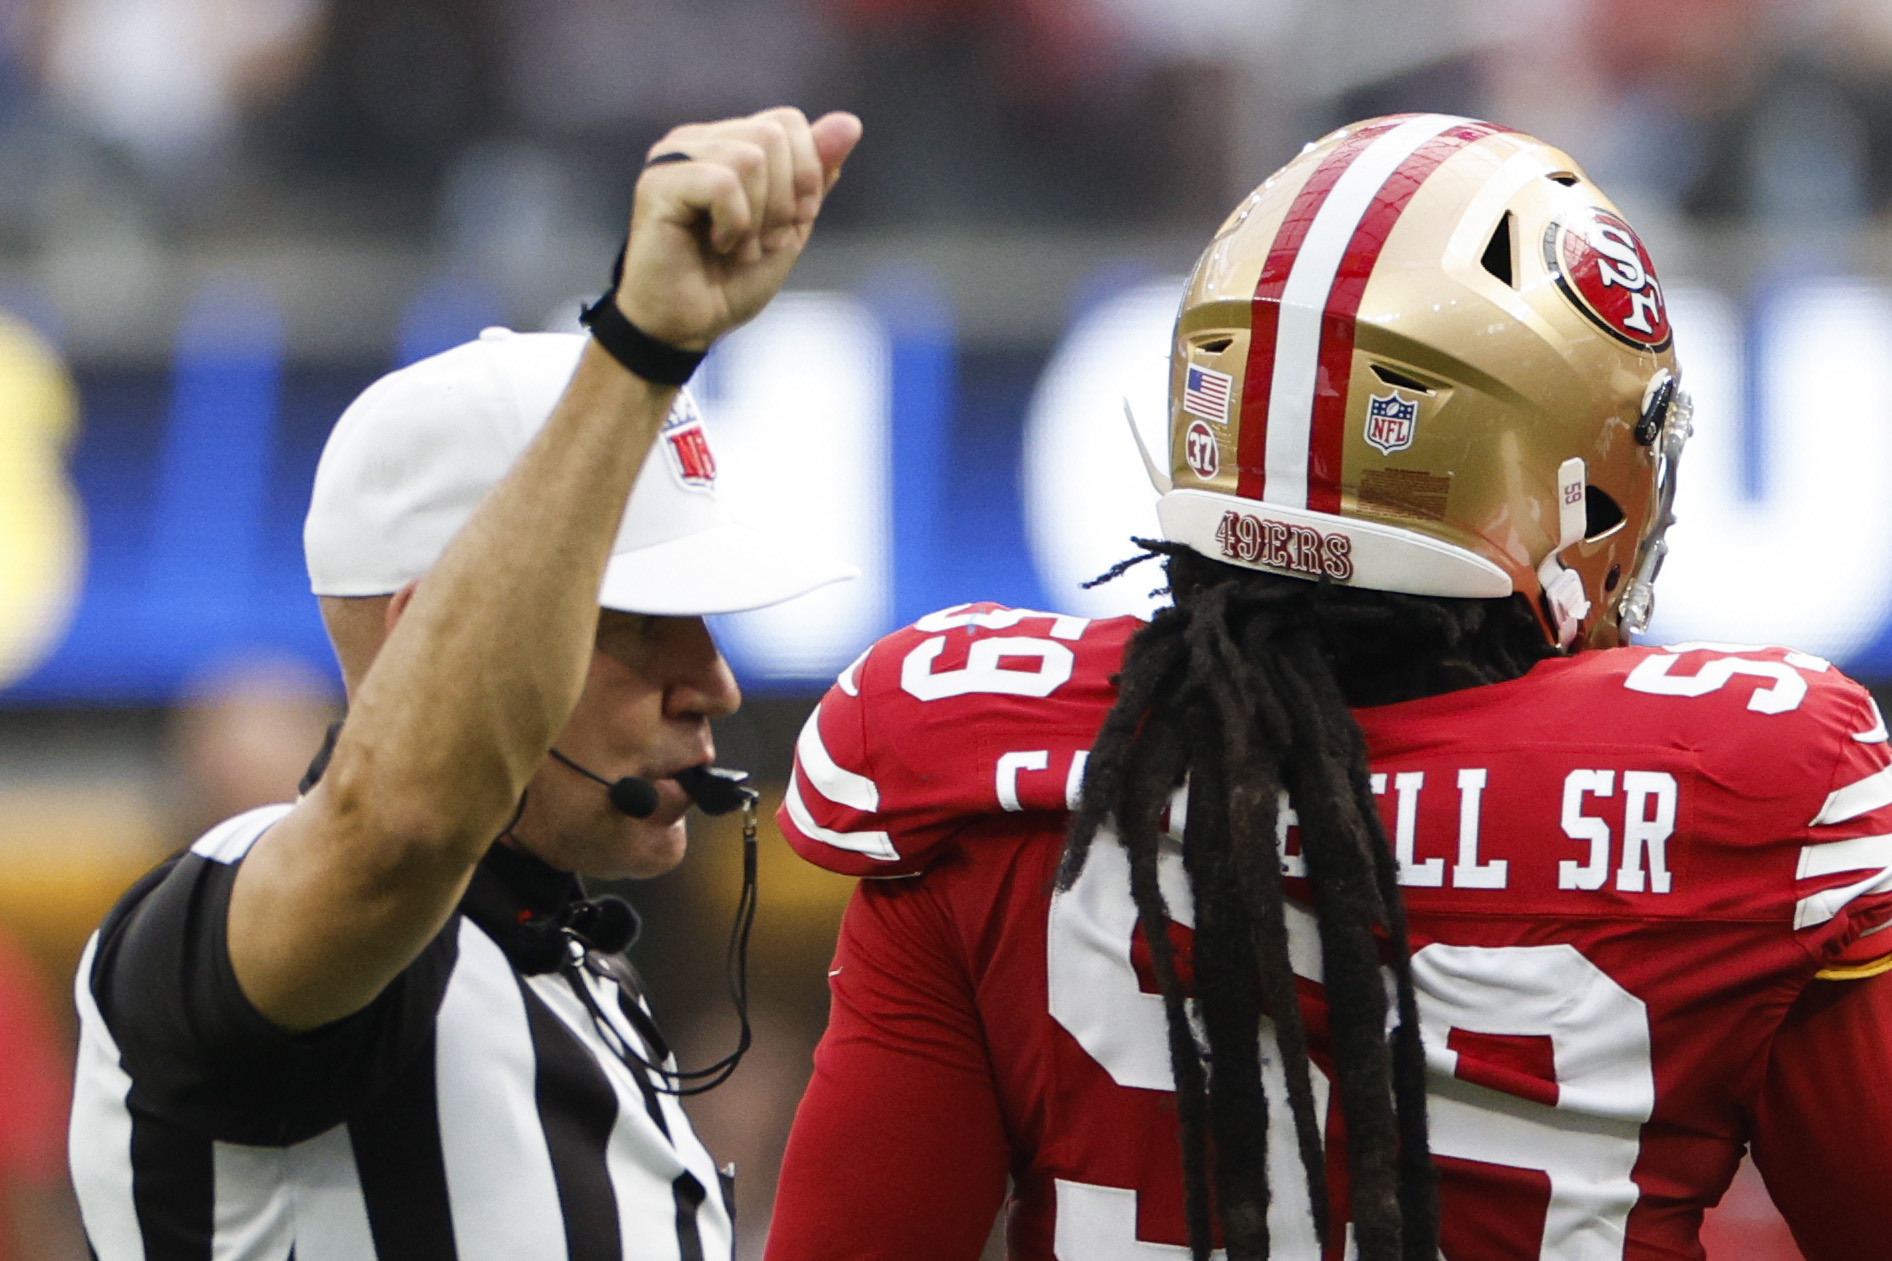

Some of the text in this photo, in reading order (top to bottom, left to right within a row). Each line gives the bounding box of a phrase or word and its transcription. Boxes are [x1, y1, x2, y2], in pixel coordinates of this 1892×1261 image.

[1189, 430, 1214, 472] 37
[1371, 417, 1406, 443] NFL
[1563, 482, 1582, 506] 59
[1215, 510, 1353, 580] 49ERS
[1558, 768, 1678, 893] SR
